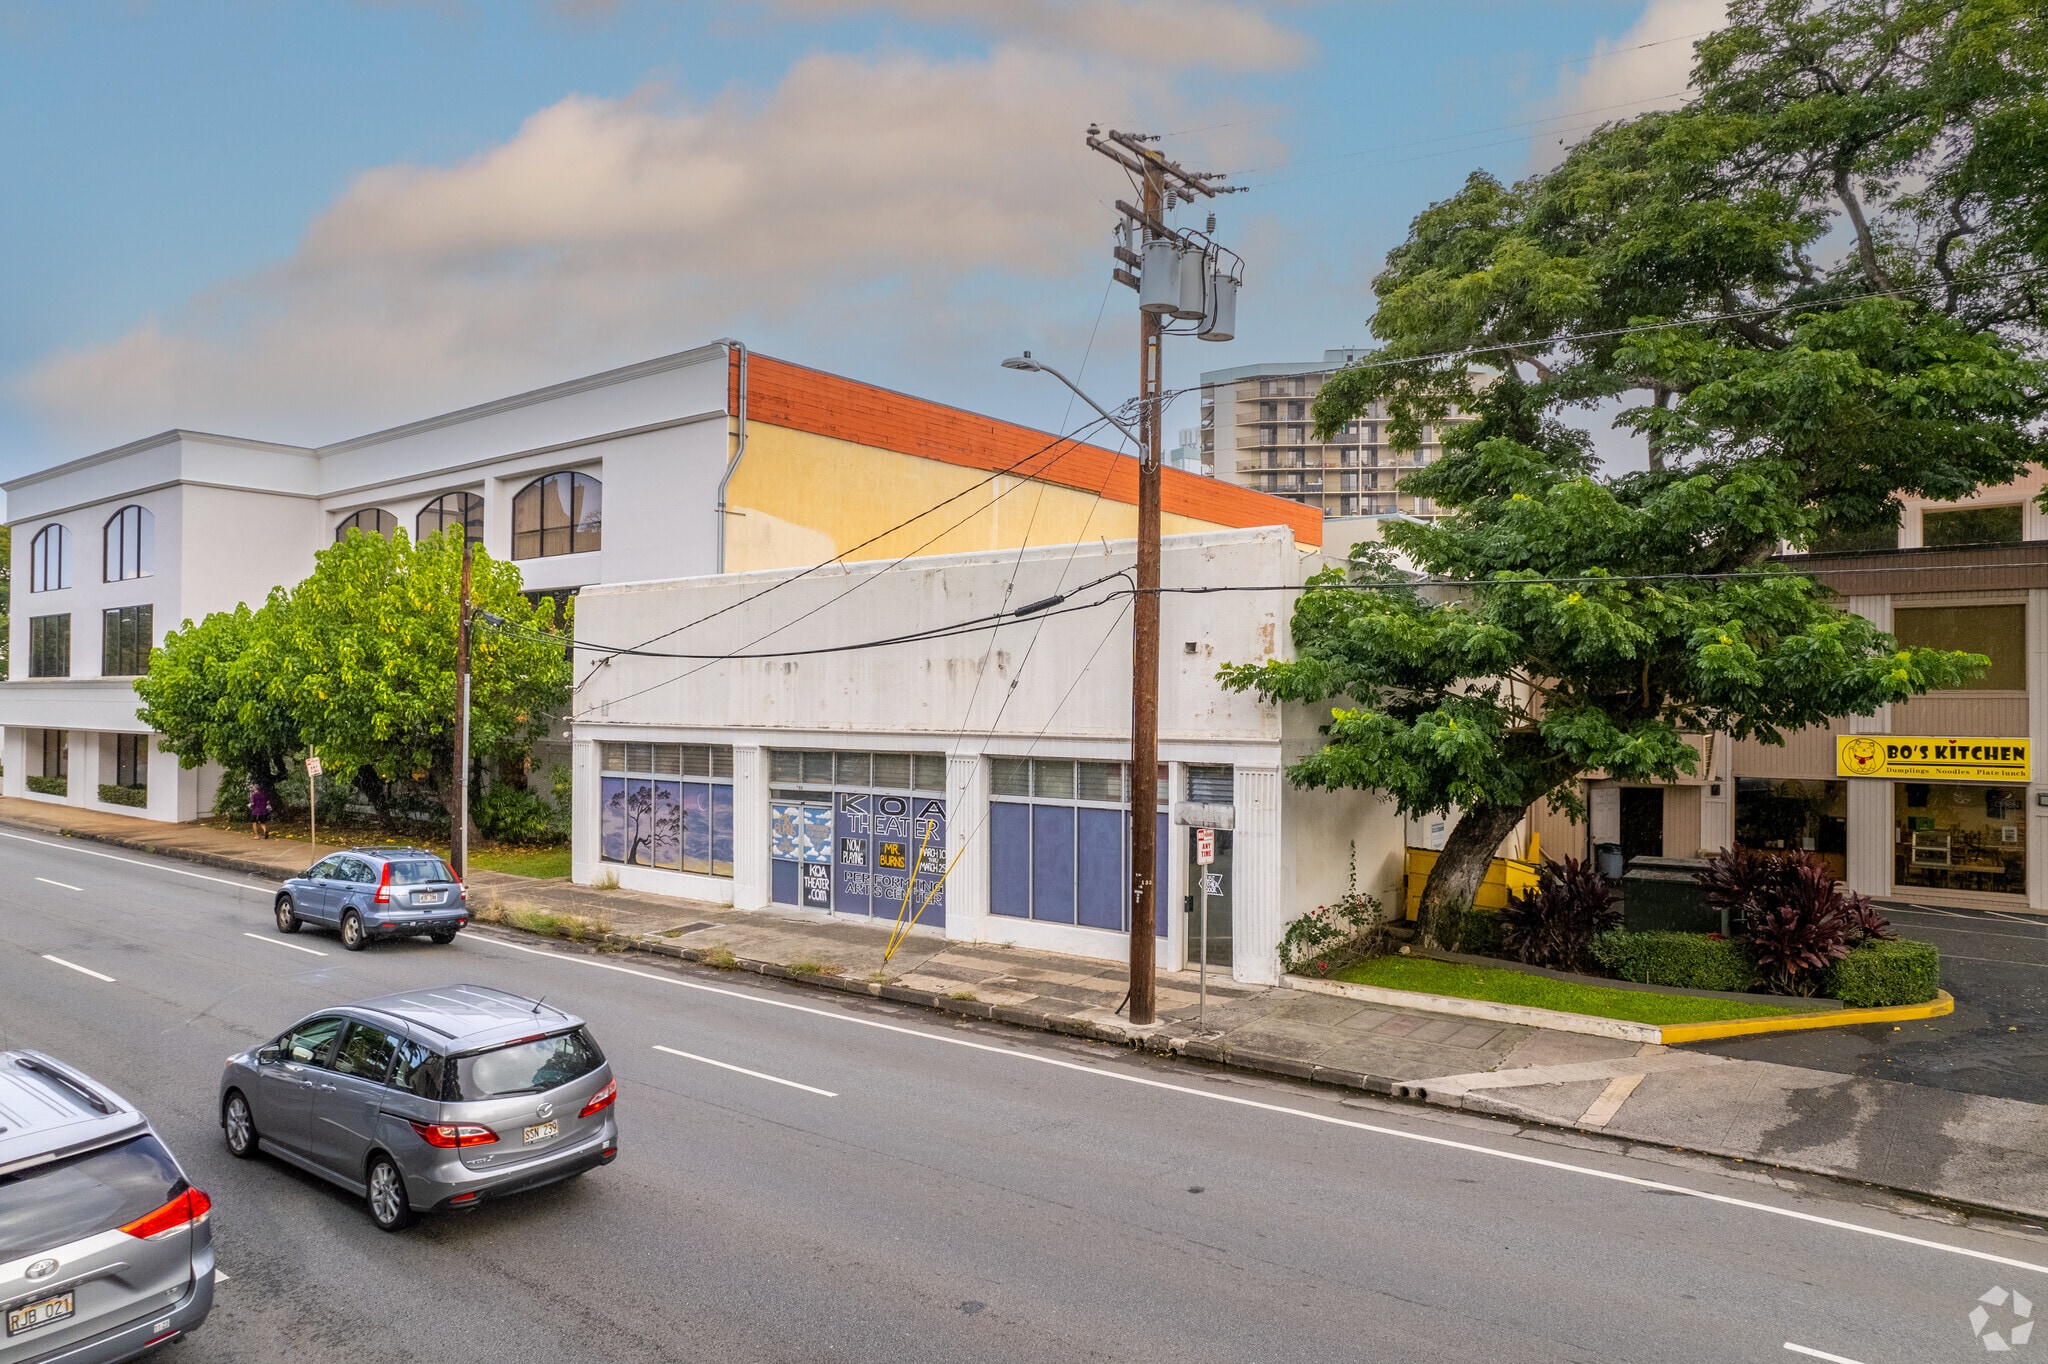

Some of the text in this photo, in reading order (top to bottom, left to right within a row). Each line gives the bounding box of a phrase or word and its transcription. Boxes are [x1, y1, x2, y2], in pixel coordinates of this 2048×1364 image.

[1887, 744, 2026, 761] BO'S KITCHEN
[1886, 767, 1930, 775] Dumplings
[840, 793, 947, 822] KOA
[847, 812, 940, 841] THEATER
[846, 839, 861, 852] NOW
[884, 843, 900, 855] MR.
[843, 851, 865, 866] PLAYING
[879, 854, 905, 869] BURNS
[809, 864, 828, 878] KOA
[804, 876, 830, 891] THEATER
[844, 871, 944, 895] PERFORMING
[845, 882, 943, 907] ARTS CENTER
[525, 1127, 539, 1141] SSN
[543, 1122, 557, 1136] 239
[10, 1309, 37, 1330] RJB
[45, 1298, 70, 1318] 021
